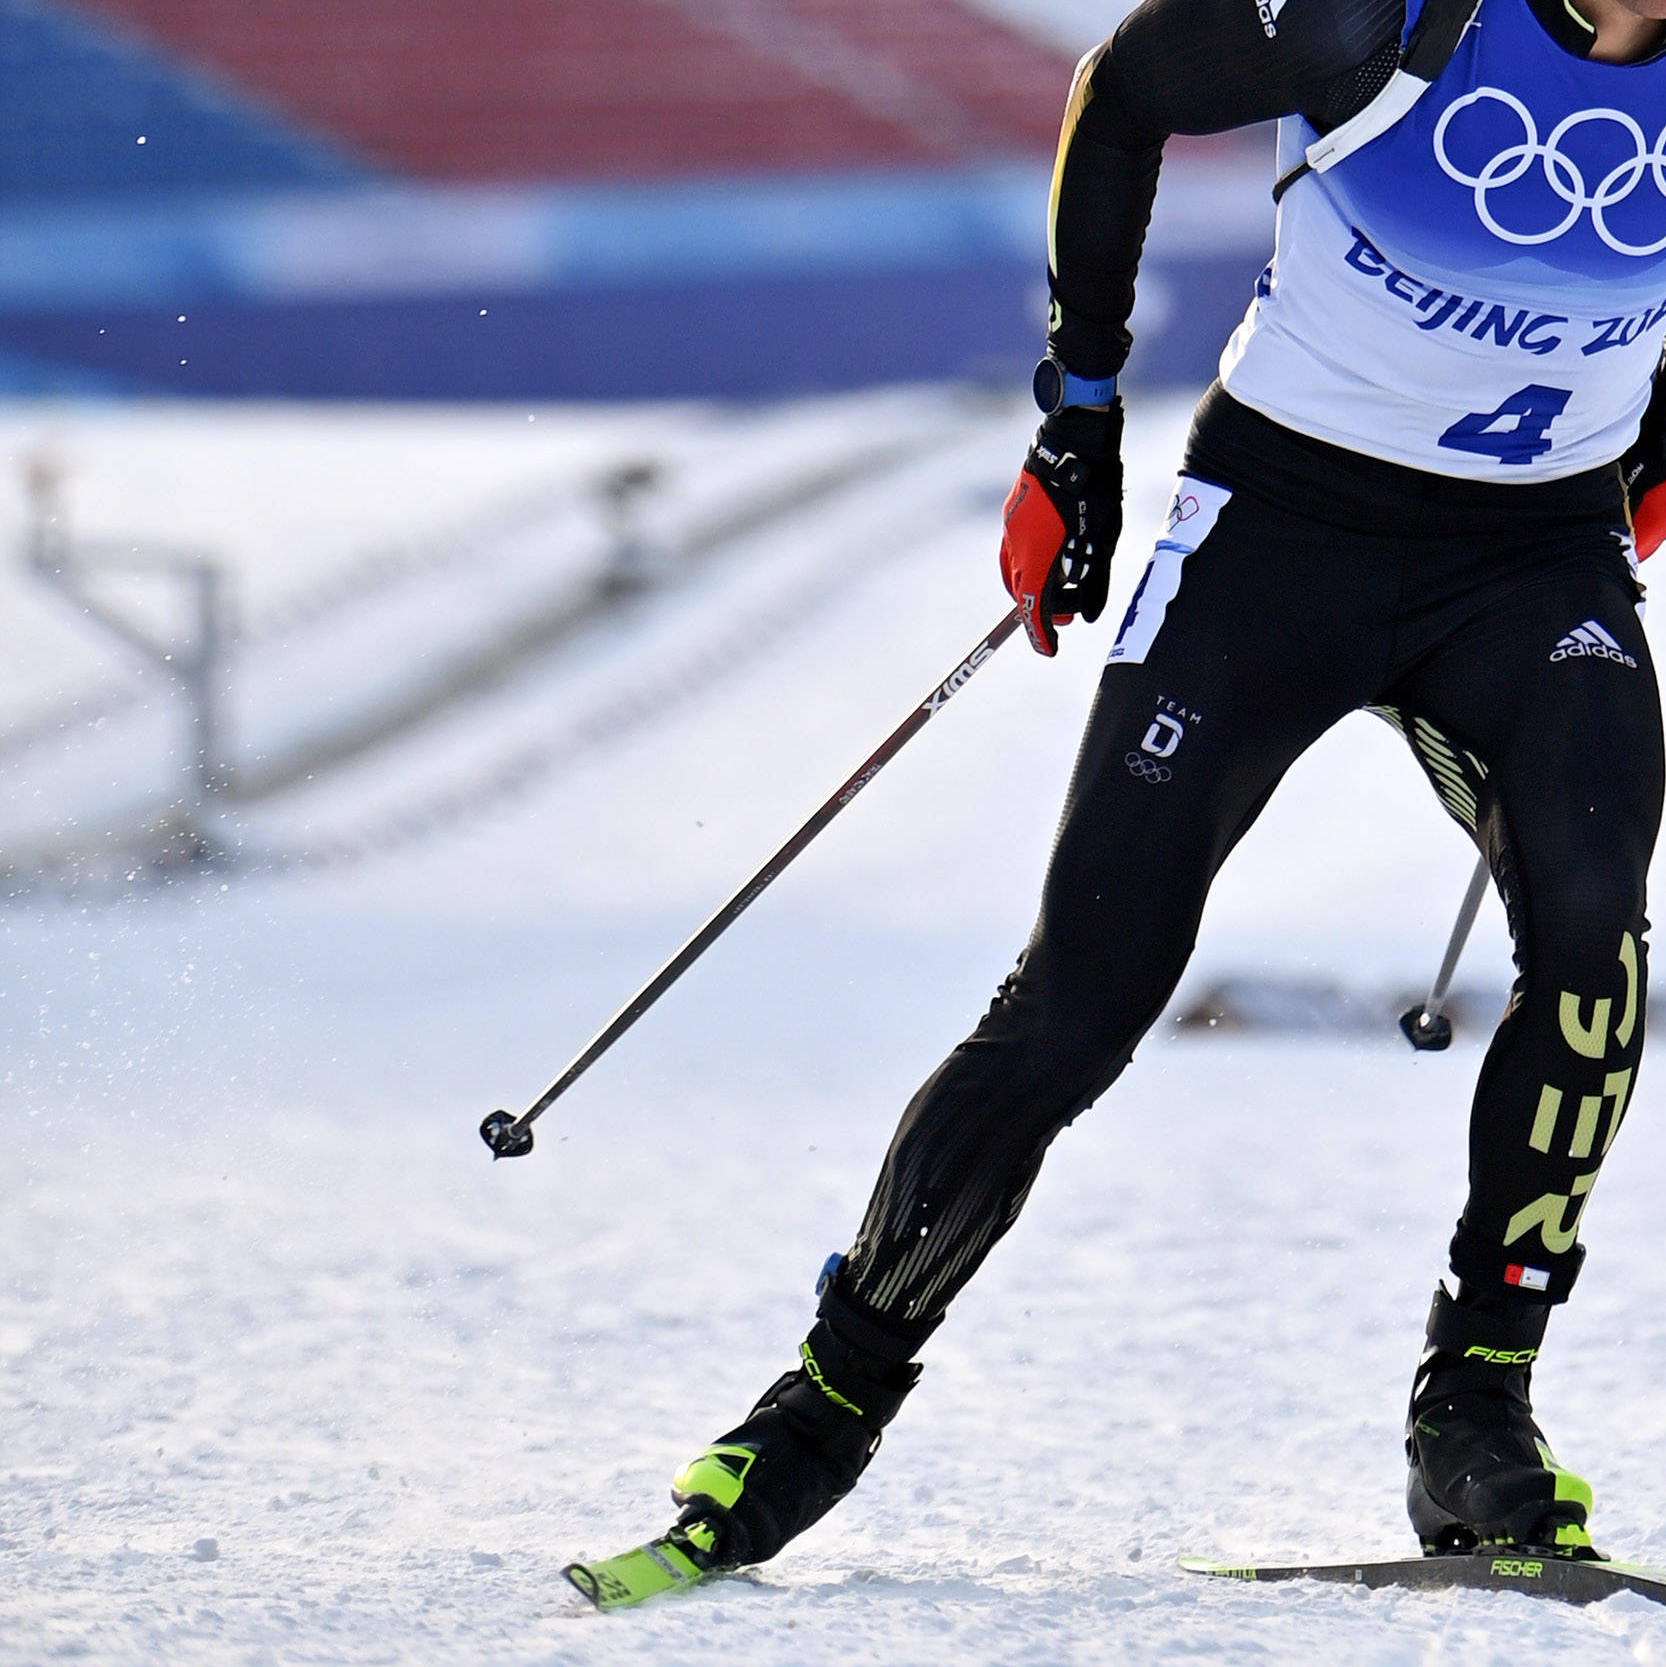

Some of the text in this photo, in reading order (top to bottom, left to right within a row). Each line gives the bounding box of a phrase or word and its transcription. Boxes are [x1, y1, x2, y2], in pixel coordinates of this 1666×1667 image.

[1437, 383, 1573, 465] 4
[1549, 642, 1638, 669] adidas
[1156, 695, 1202, 724] TEAM
[1502, 930, 1639, 1254] GER
[1490, 1559, 1543, 1578] FISCHER
